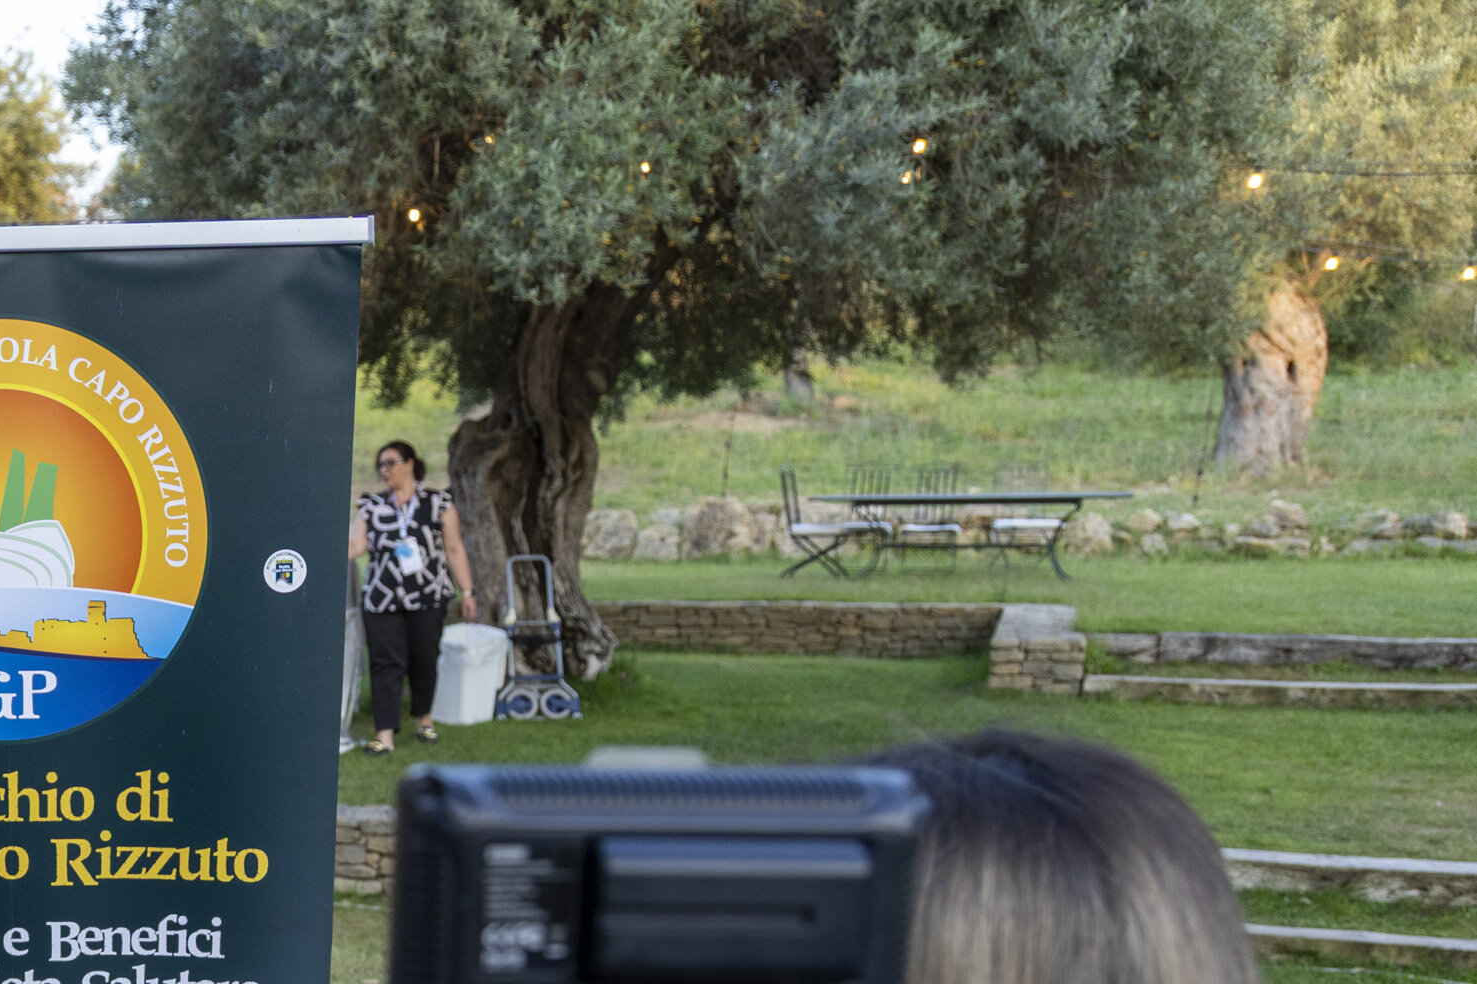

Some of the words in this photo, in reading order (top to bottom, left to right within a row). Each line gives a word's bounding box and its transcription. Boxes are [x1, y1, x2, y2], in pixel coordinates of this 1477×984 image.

[67, 357, 145, 425] CAPO
[137, 423, 190, 568] RIZZUTO
[116, 769, 174, 823] di
[50, 829, 269, 887] Rizzuto
[3, 927, 30, 956] e
[46, 913, 225, 962] Benefici
